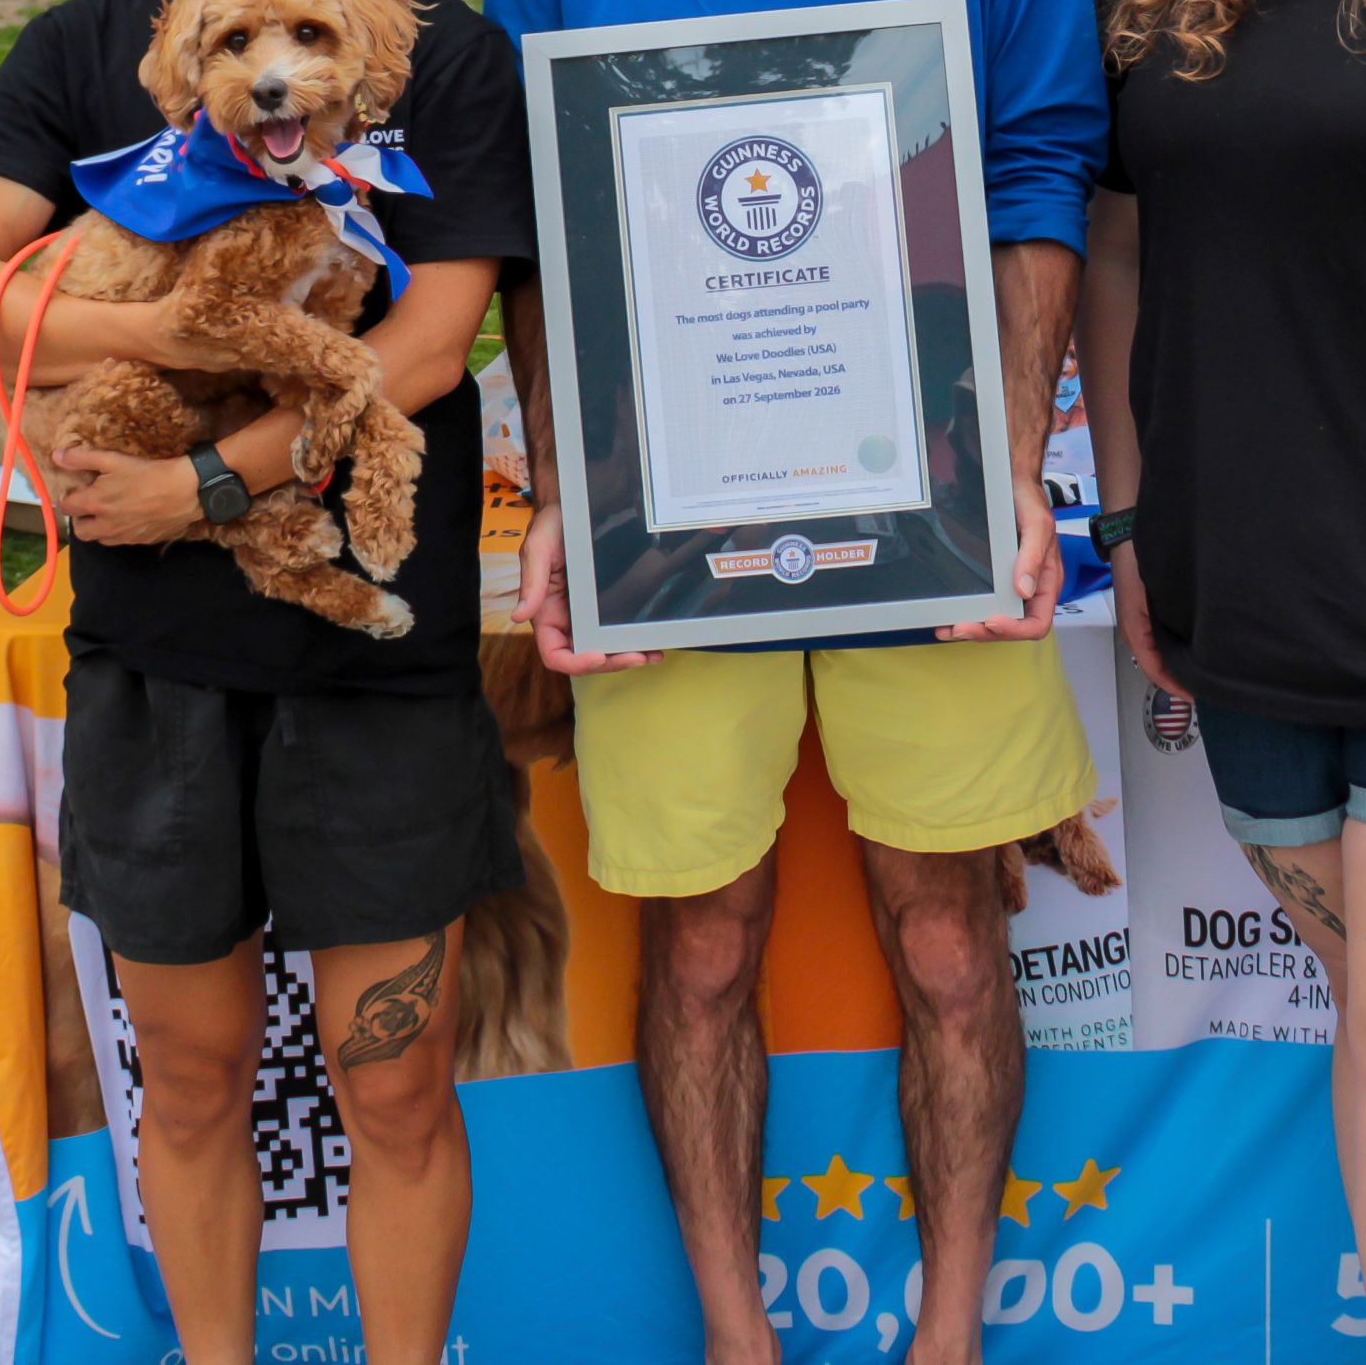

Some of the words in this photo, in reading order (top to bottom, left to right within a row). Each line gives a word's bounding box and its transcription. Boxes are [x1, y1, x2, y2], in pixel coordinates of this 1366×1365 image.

[712, 143, 803, 180] GUINNESS
[704, 194, 750, 252] WORLD
[756, 185, 815, 255] RECORDS
[705, 266, 830, 290] CERTIFICATE
[675, 315, 695, 325] The
[697, 312, 724, 323] most
[726, 308, 751, 322] dogs
[753, 303, 805, 318] attending
[807, 304, 814, 313] a
[815, 300, 839, 314] pool
[841, 298, 870, 313] party
[732, 332, 753, 341] was
[754, 325, 801, 339] achieved
[803, 324, 817, 336] by
[716, 352, 732, 363] We
[735, 349, 760, 362] Love
[762, 345, 805, 360] Doodles
[807, 342, 837, 356] (USA)
[711, 375, 721, 385] in
[723, 373, 741, 384] Las
[743, 370, 777, 384] Vegas,
[778, 365, 821, 379] Nevada,
[823, 363, 846, 375] USA
[723, 395, 737, 405] on
[739, 392, 751, 404] 27
[754, 387, 812, 404] September
[813, 384, 841, 397] 2026
[721, 470, 788, 484] OFFICIALLY
[792, 464, 848, 478] AMAZING
[720, 557, 769, 570] RECORD
[816, 548, 865, 562] HOLDER
[1182, 906, 1262, 951] DOG
[1165, 952, 1297, 982] DETANGLER
[1303, 955, 1318, 980] &
[1041, 969, 1132, 1006] CONDITIO
[1027, 1027, 1073, 1043] WITH
[1209, 1019, 1264, 1042] MADE
[1272, 1026, 1328, 1045] WITH
